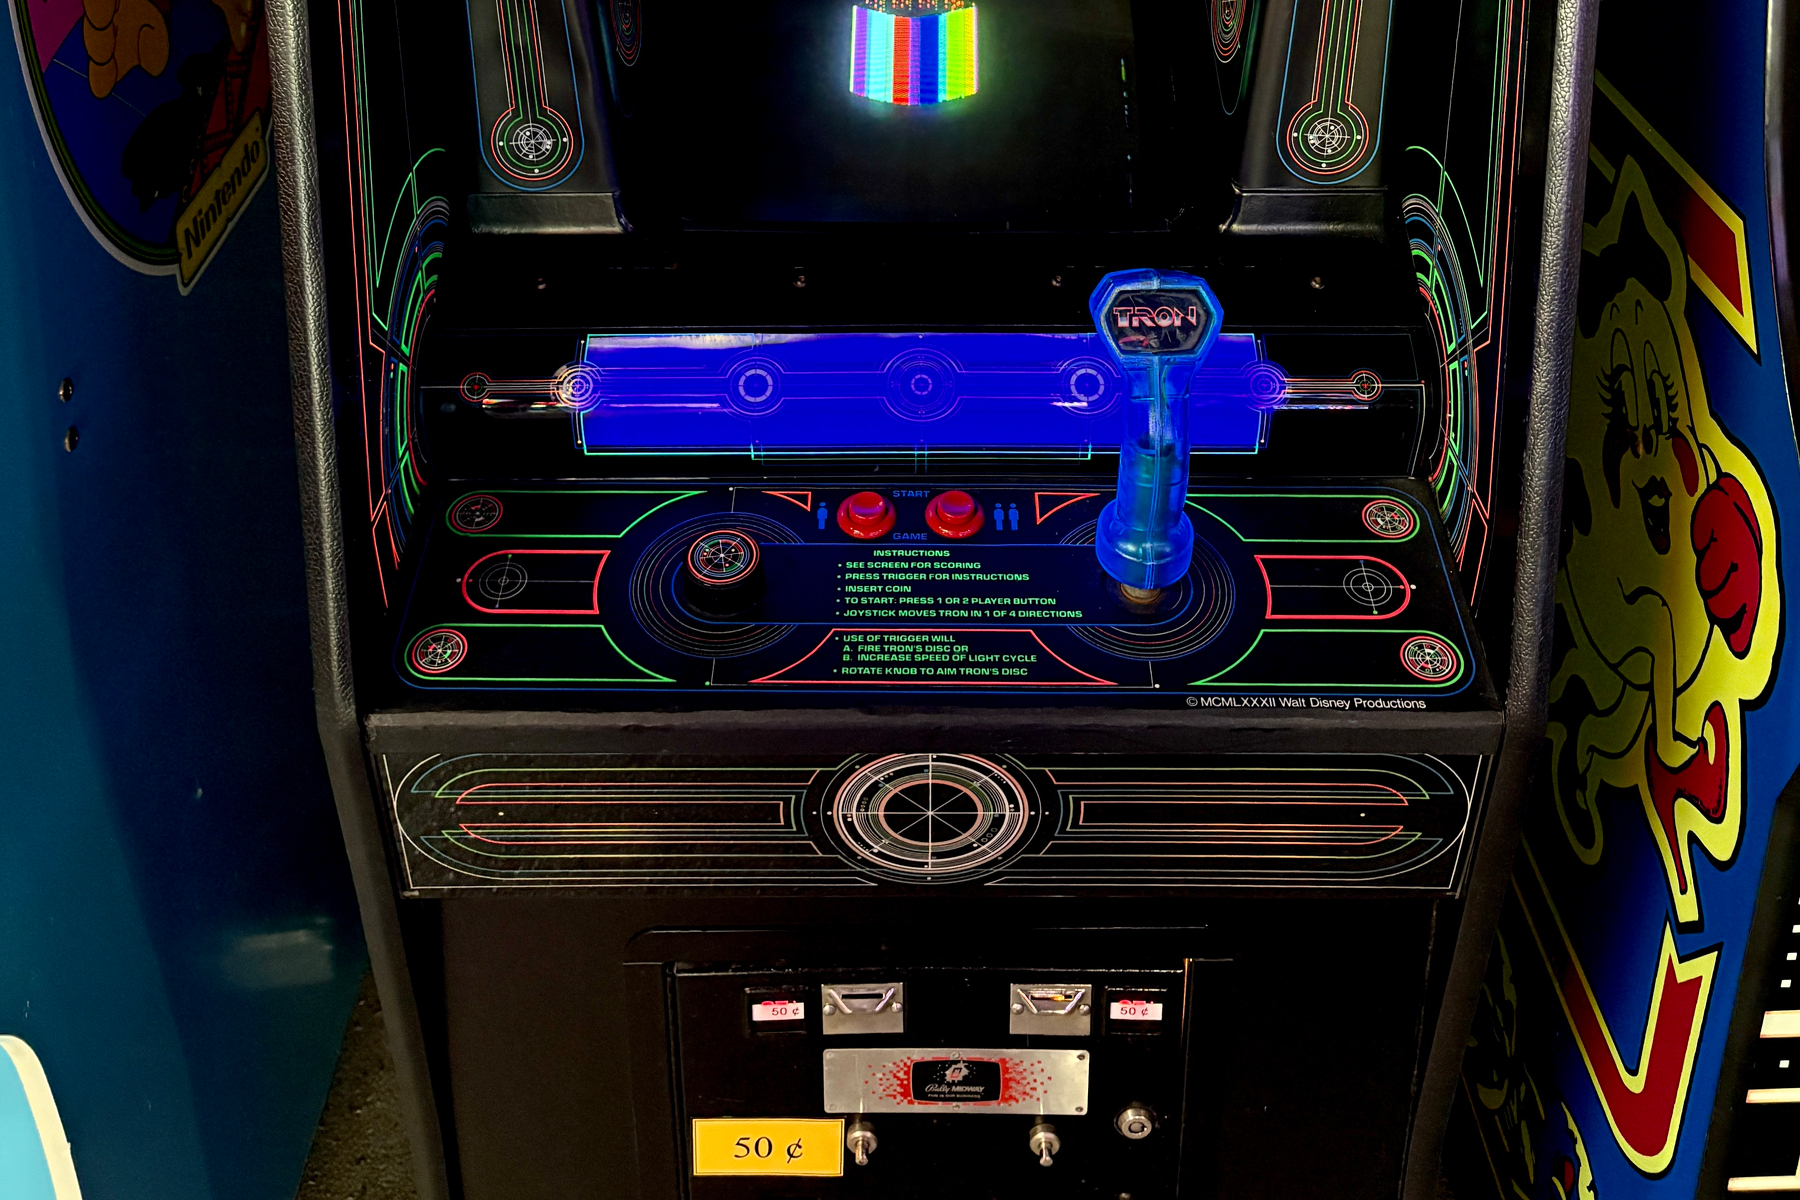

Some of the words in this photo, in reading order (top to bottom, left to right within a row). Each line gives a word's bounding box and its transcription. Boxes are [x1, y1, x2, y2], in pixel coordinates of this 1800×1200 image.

[183, 139, 261, 260] Nintendo
[1112, 305, 1198, 328] TRON
[892, 490, 930, 498] START
[892, 532, 928, 540] GAME
[873, 549, 951, 557] INSTRUCTIONS
[845, 561, 865, 569] SEE
[866, 561, 909, 569] SCREEN
[910, 561, 932, 569] FOR
[933, 561, 982, 569] SCORING
[845, 572, 880, 580] PRESS
[881, 572, 927, 580] TRIGGER
[928, 573, 950, 581] FOR
[951, 573, 1030, 581] INSTRUCTIONS
[845, 585, 884, 593] INSERT
[885, 585, 912, 593] COIN
[844, 596, 859, 604] TO
[860, 596, 897, 605] START:
[899, 596, 935, 605] PRESS
[936, 596, 942, 604] 1
[945, 597, 961, 605] OR
[962, 597, 969, 605] 2
[971, 597, 1012, 605] PLAYER
[1013, 597, 1057, 605] BUTTON
[843, 609, 896, 617] JOYSTICK
[898, 609, 937, 617] MOVES
[938, 609, 969, 617] TRON
[970, 610, 982, 618] IN
[992, 610, 1007, 618] OF
[1008, 610, 1016, 618] 4
[1018, 610, 1083, 618] DIRECTIONS
[843, 634, 865, 642] USE
[866, 634, 881, 642] OF
[882, 634, 929, 643] TRIGGER
[930, 634, 956, 643] WILL
[842, 644, 853, 652] A.
[857, 644, 881, 652] FIRE
[882, 644, 923, 653] TRON'S
[924, 644, 951, 653] DISC
[952, 644, 969, 653] OR
[842, 653, 853, 661] B.
[857, 653, 912, 662] INCREASE
[914, 653, 950, 662] SPEED
[951, 654, 967, 662] OF
[968, 654, 1000, 662] LIGHT
[1002, 654, 1037, 663] CYCLE
[841, 667, 883, 675] ROTATE
[885, 667, 918, 675] KNOB
[919, 667, 935, 675] TO
[936, 667, 957, 676] AIM
[958, 667, 1000, 676] TRON'S
[1001, 667, 1028, 676] DISC
[1200, 696, 1276, 708] MCMLXXXII
[1279, 697, 1307, 708] Walt
[1309, 697, 1351, 710] Disney
[1353, 697, 1427, 710] Productions
[771, 1006, 788, 1017] 50
[1120, 1006, 1137, 1016] 50
[733, 1136, 774, 1159] 50
